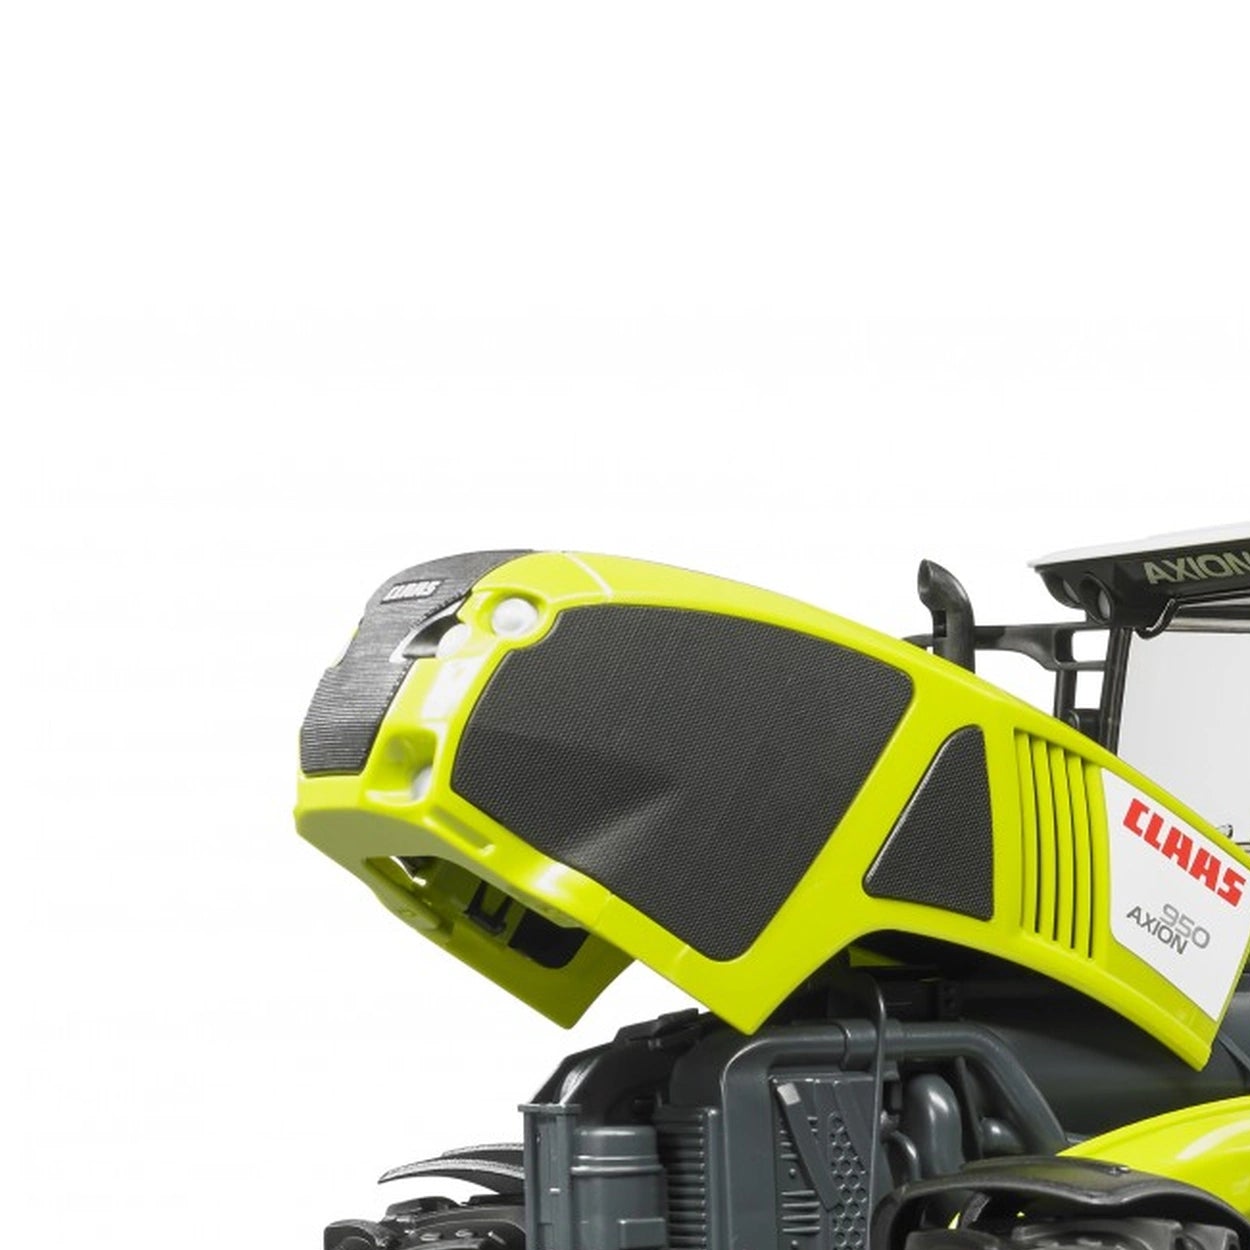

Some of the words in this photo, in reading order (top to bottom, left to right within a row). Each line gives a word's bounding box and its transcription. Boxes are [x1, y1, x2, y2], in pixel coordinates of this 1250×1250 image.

[1123, 798, 1246, 907] CLAAS
[1126, 906, 1187, 954] AXION
[1159, 903, 1211, 949] 950
